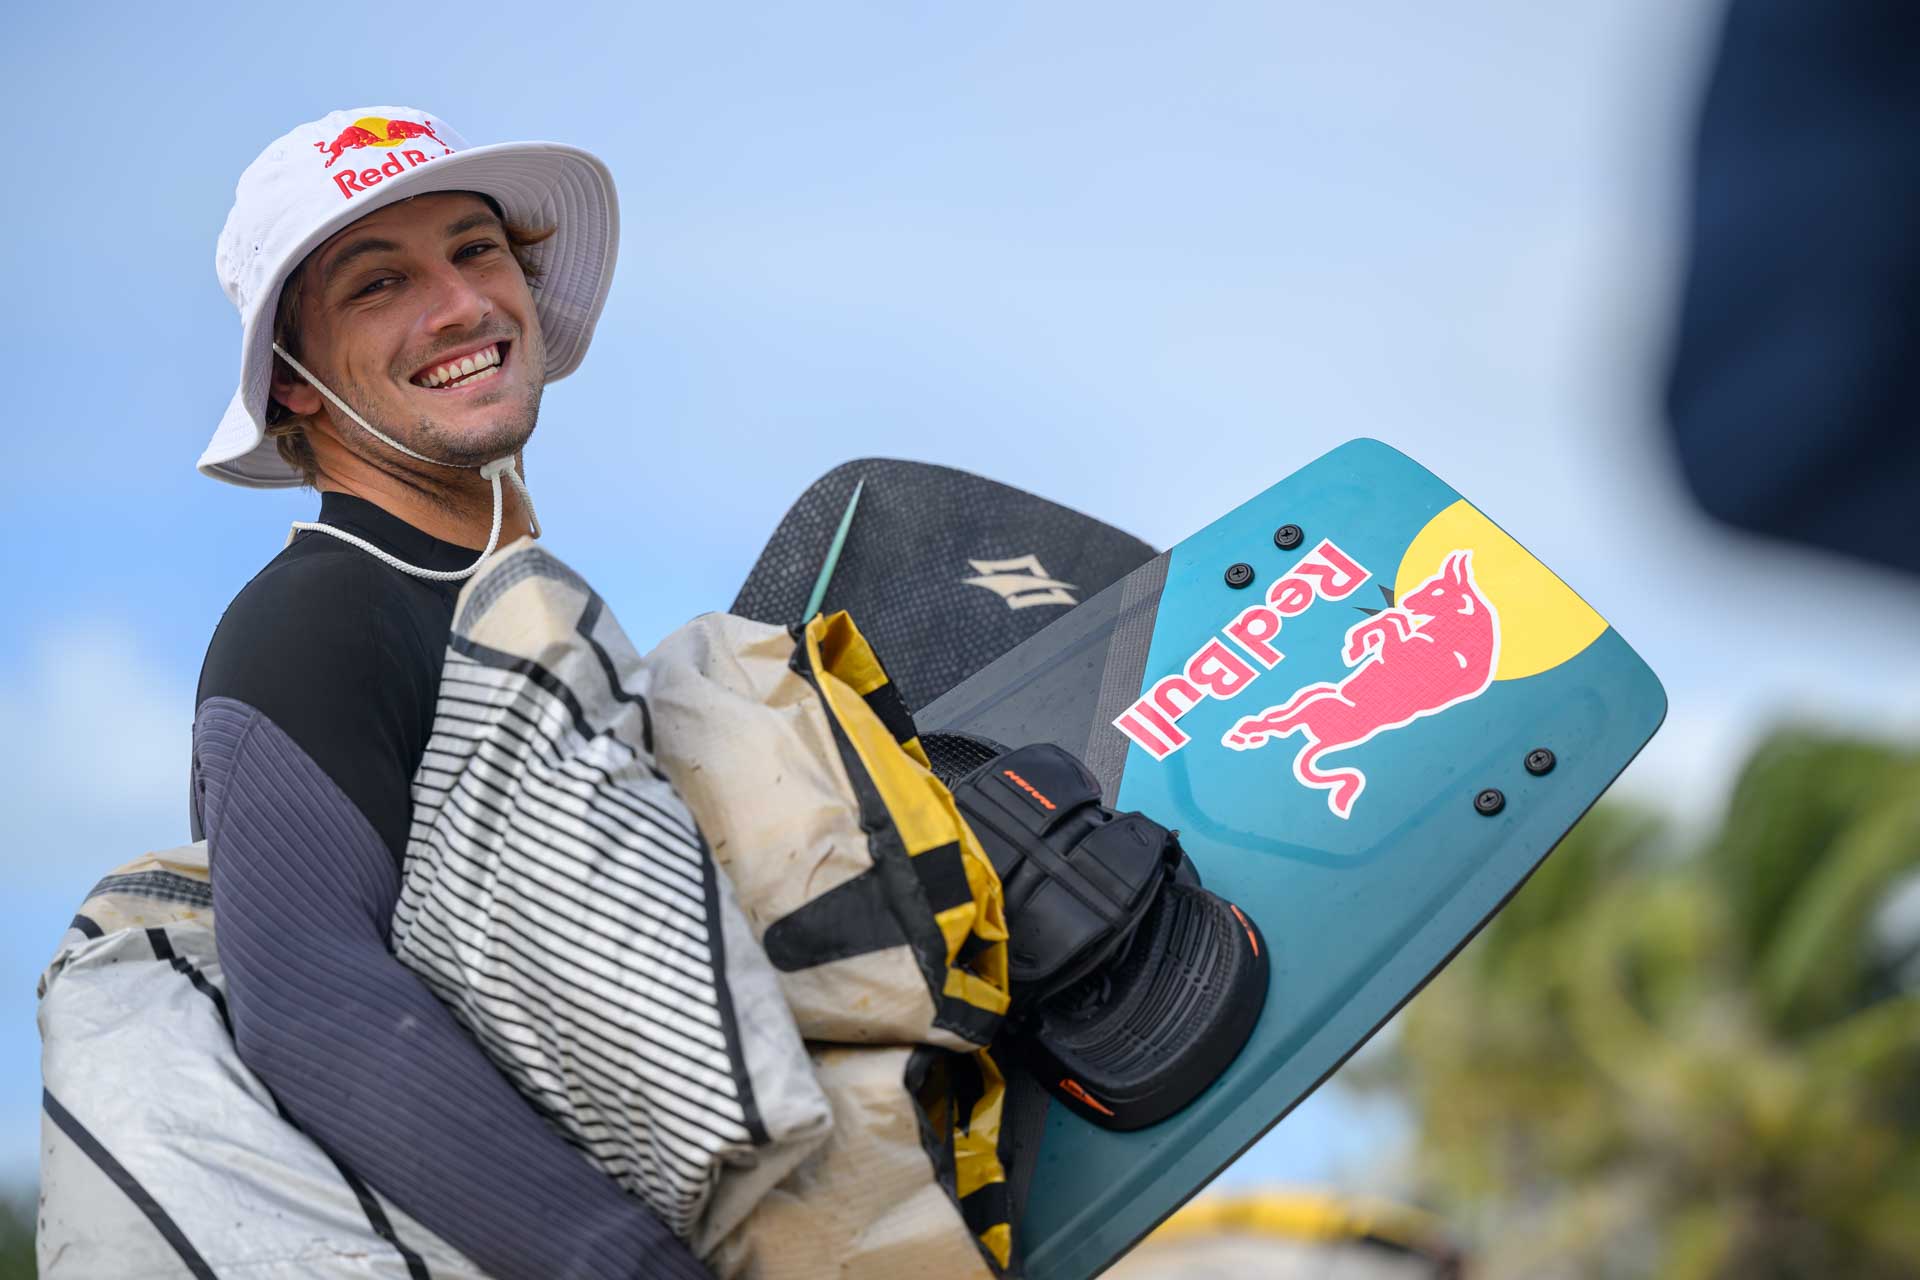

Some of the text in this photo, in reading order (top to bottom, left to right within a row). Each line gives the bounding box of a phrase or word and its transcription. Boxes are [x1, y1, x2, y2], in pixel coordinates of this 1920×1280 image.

[332, 151, 405, 200] Red
[1117, 541, 1370, 758] Red Bull
